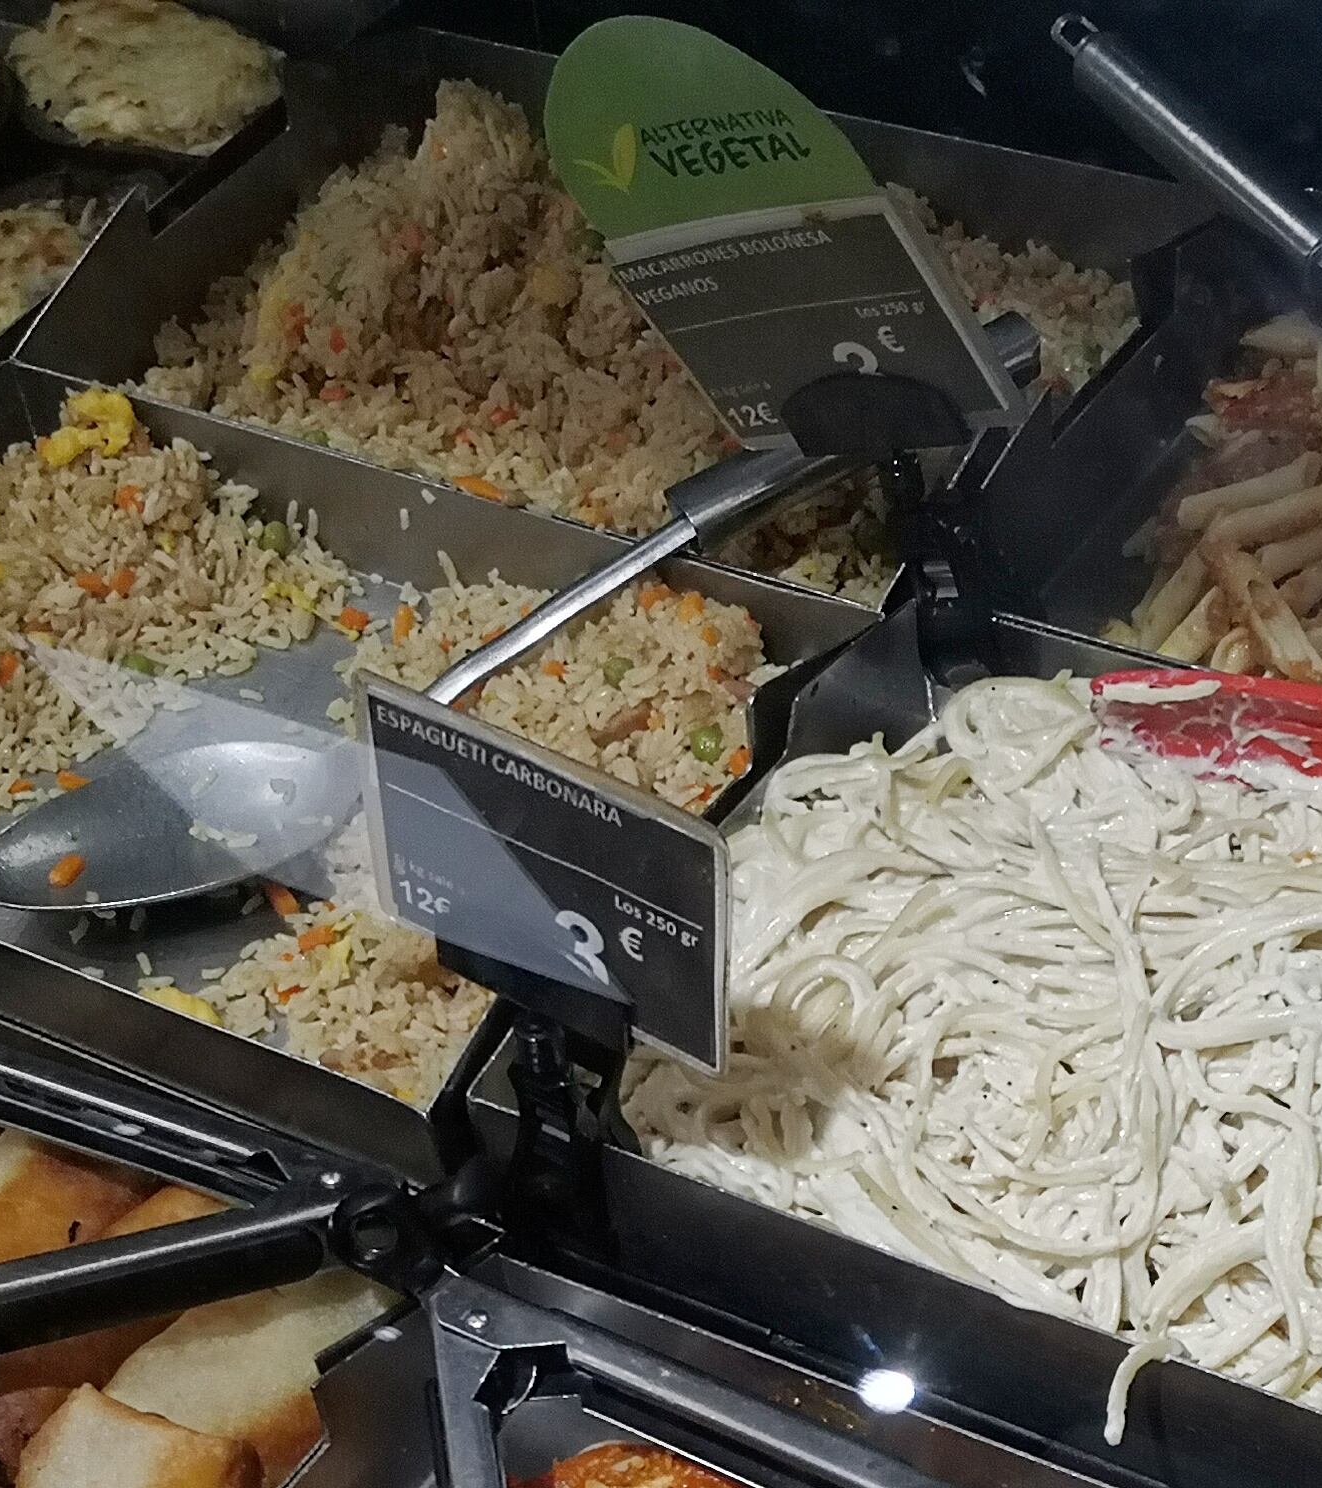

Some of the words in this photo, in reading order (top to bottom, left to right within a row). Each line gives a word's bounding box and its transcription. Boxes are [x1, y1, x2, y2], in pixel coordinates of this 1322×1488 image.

[640, 109, 795, 147] ALTERNATIVA
[649, 131, 812, 178] VEGETAL
[618, 242, 740, 284] MACARRONES
[635, 275, 720, 306] VEGANOS
[880, 301, 909, 316] 250
[877, 325, 906, 353] €
[727, 401, 779, 428] 12€
[376, 704, 487, 766] ESPAGUETI
[491, 753, 624, 828] CARBONARA
[614, 895, 643, 920] Los
[645, 911, 677, 937] 250
[680, 931, 699, 948] gr
[617, 926, 644, 962] €
